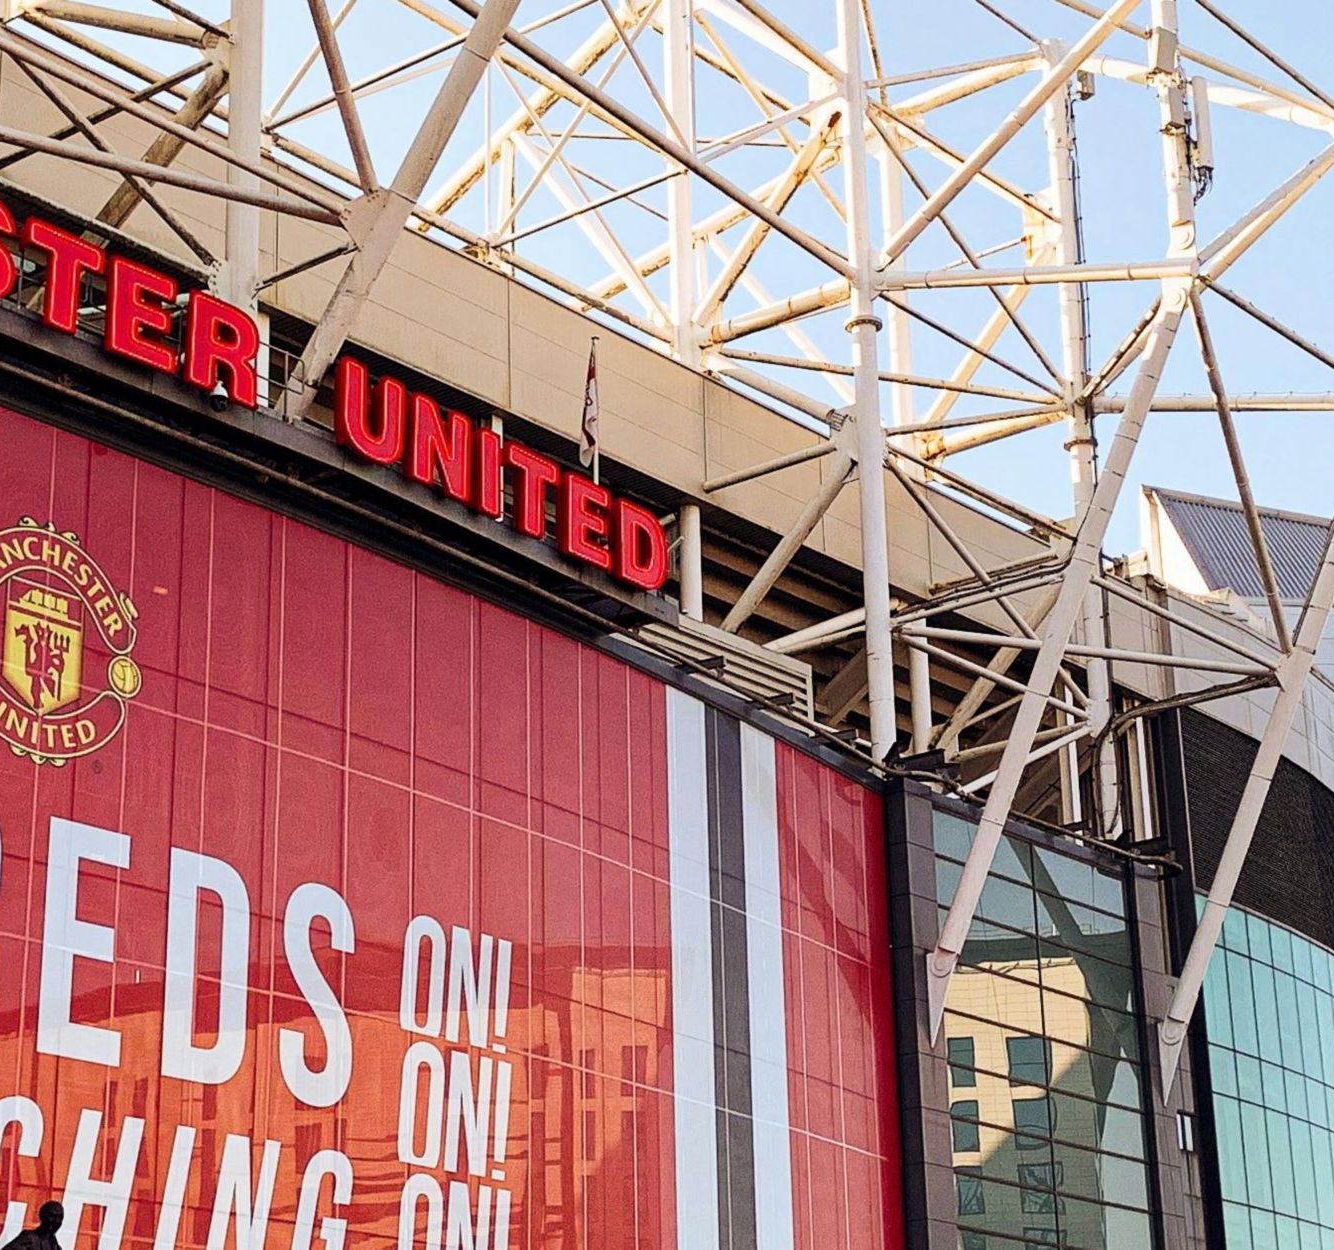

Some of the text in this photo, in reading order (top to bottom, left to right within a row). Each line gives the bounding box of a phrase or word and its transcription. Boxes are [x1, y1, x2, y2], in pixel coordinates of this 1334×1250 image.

[334, 353, 669, 590] UNITED
[399, 915, 512, 1054] ON!
[397, 1041, 512, 1181] ON!
